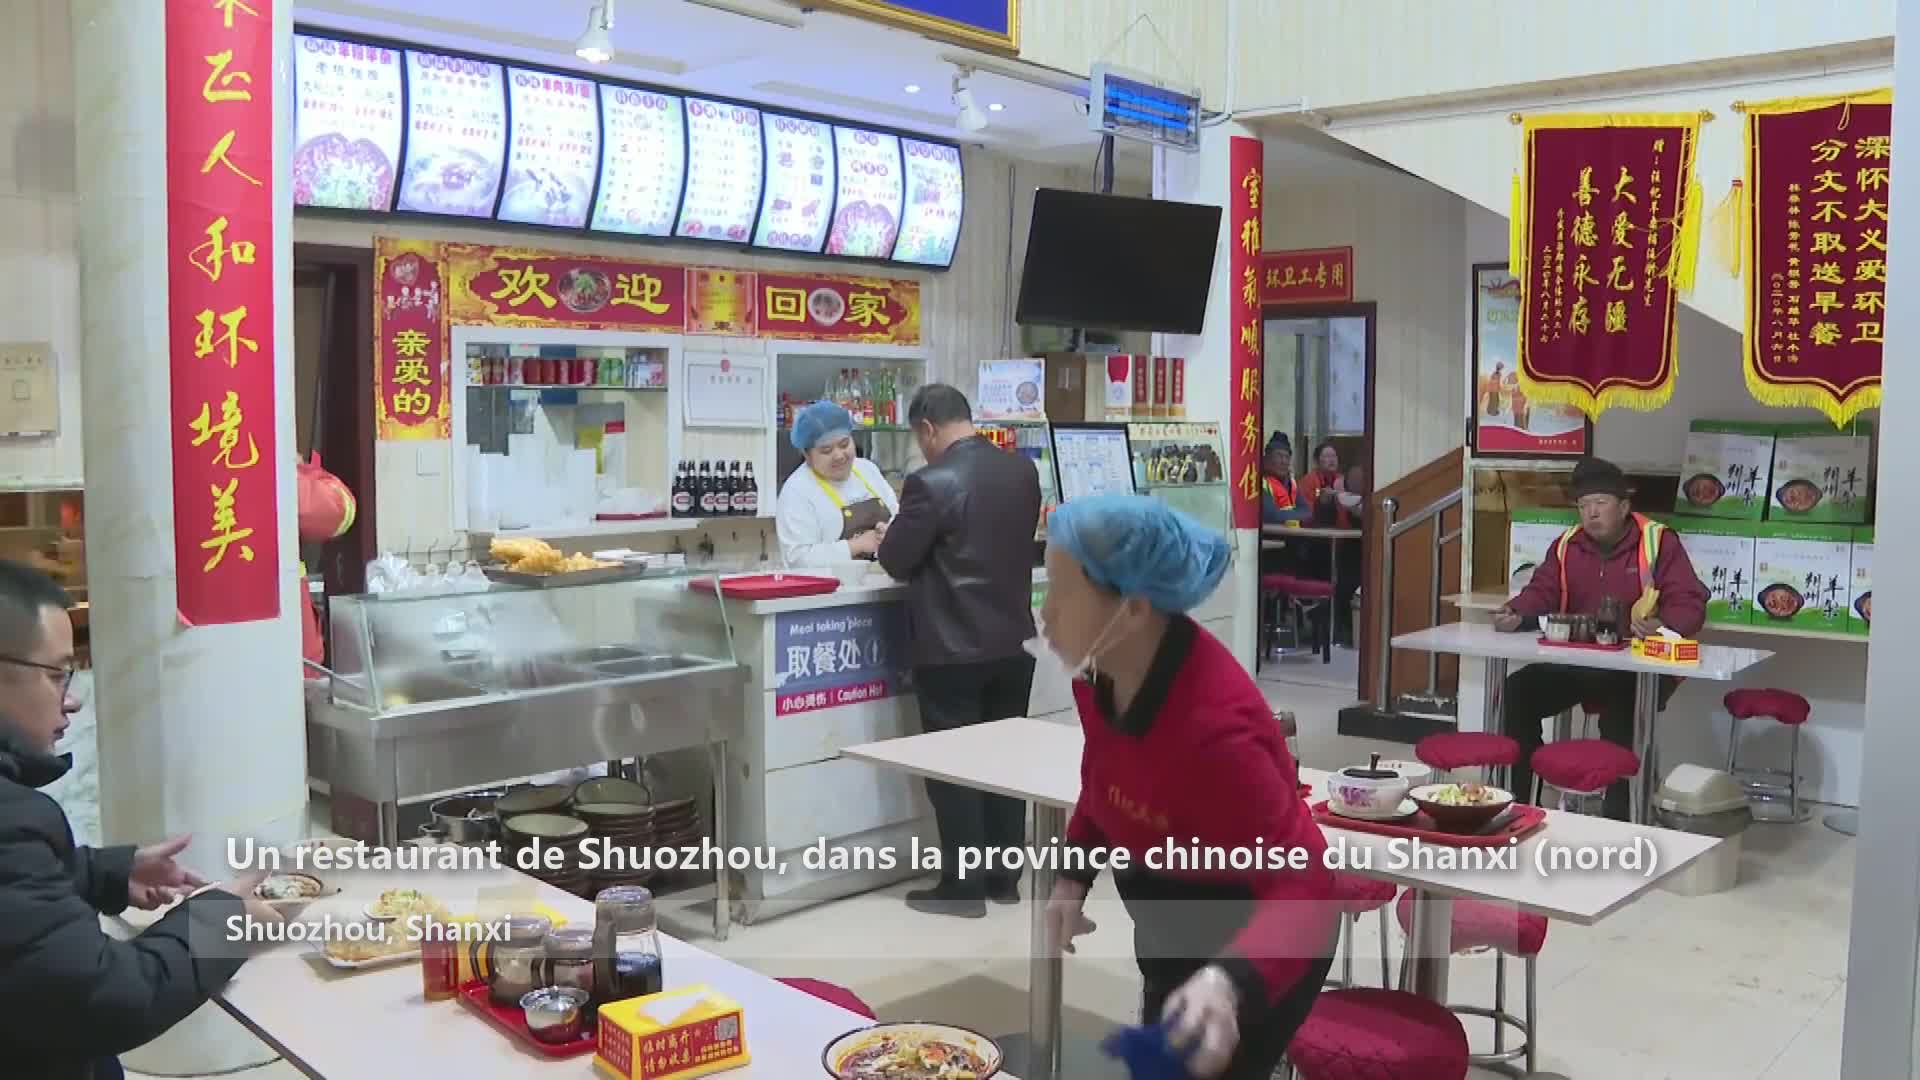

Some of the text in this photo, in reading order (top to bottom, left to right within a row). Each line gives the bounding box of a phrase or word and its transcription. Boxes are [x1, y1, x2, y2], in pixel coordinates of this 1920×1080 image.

[1266, 260, 1344, 289] 环卫工专用
[1604, 166, 1638, 334] 大爱无疆
[1809, 138, 1848, 347] 分文不取送早餐
[1851, 135, 1889, 343] 深怀大义爱环卫
[490, 266, 892, 328] 欢迎 回家
[392, 328, 431, 415] 亲爱的
[787, 638, 861, 679] 取餐处
